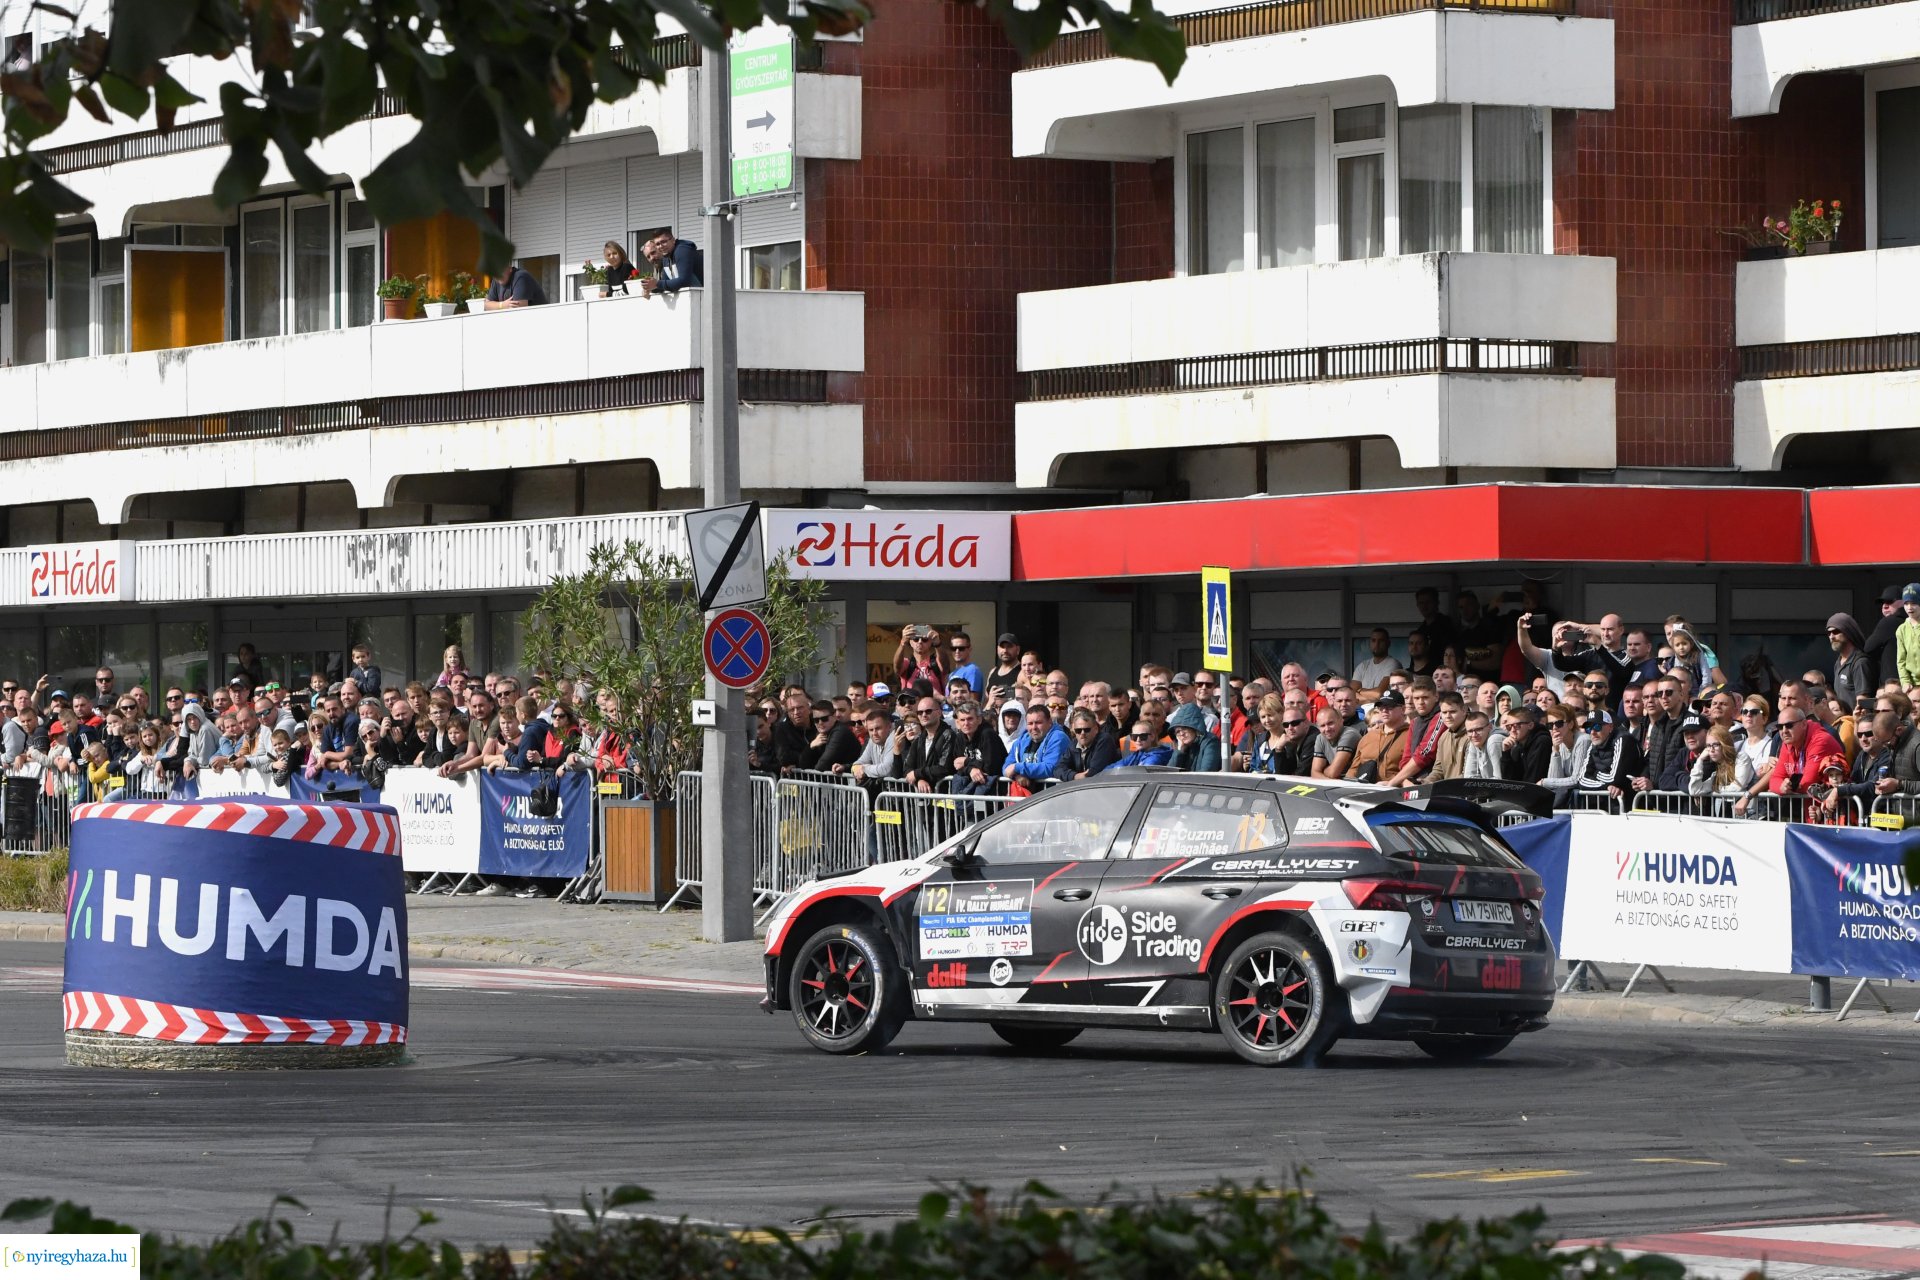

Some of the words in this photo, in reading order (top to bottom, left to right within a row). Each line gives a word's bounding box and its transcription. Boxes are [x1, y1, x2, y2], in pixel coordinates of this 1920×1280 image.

[744, 52, 778, 70] CENTRUM
[841, 523, 980, 568] Háda
[52, 549, 116, 595] Háda
[414, 792, 453, 815] HUMDA
[516, 795, 563, 820] HUA
[523, 824, 540, 835] ROAD
[540, 824, 565, 836] SAFETY
[1176, 828, 1225, 841] Cuzma
[1236, 812, 1268, 852] 12
[1211, 858, 1360, 871] CBRALLYVEST
[1645, 852, 1738, 886] HUMDA
[927, 888, 948, 912] 12
[966, 899, 989, 912] RALLY
[1616, 890, 1658, 905] HUMDA
[1663, 892, 1694, 906] ROAD
[1699, 894, 1738, 909] SAFETY
[1839, 901, 1881, 917] HUMDA
[1883, 904, 1920, 920] ROAD
[1131, 911, 1177, 934] Side
[1459, 902, 1476, 920] TM
[1479, 903, 1512, 922] 75WRC
[1614, 912, 1624, 925] A
[1627, 909, 1690, 928] BIZTONSÁG
[1693, 915, 1708, 929] AZ
[102, 869, 403, 979] HUMDA
[988, 925, 1028, 937] HUMDA
[1081, 918, 1123, 943] side
[1839, 923, 1848, 938] A
[1851, 921, 1917, 942] BIZTONSÁG
[1001, 941, 1028, 949] TRP
[1131, 935, 1202, 962] Trading
[1445, 936, 1527, 950] CBRALLYVEST
[927, 962, 969, 987] dalli
[1482, 953, 1521, 989] dalli
